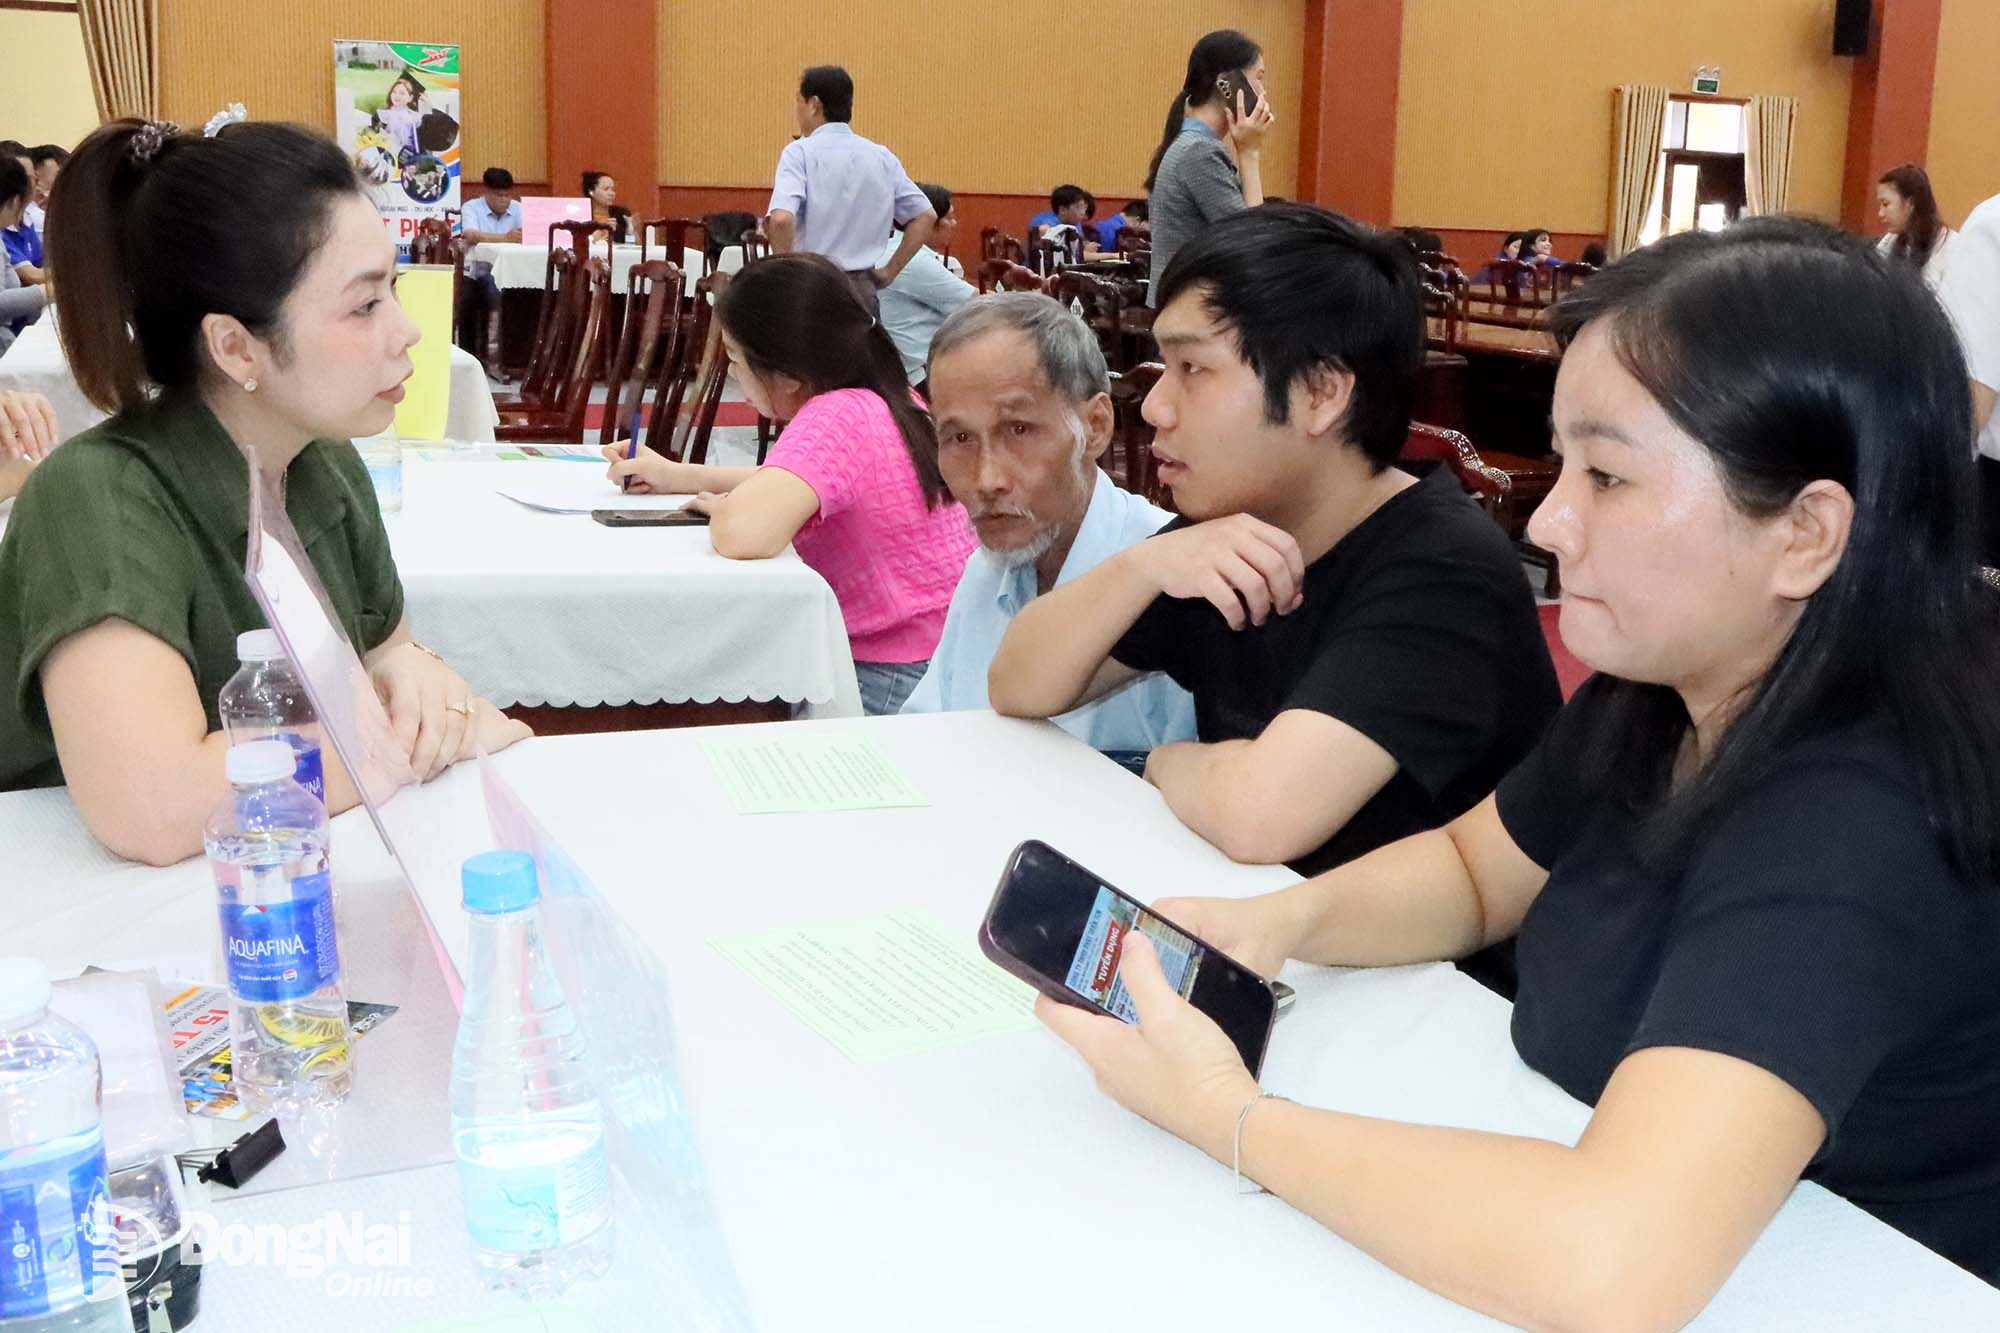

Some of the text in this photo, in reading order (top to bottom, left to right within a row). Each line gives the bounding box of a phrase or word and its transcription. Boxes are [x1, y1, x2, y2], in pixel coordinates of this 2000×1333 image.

[229, 934, 308, 960] AQUAFINA
[1098, 928, 1120, 981] TUYỂN DỤNG
